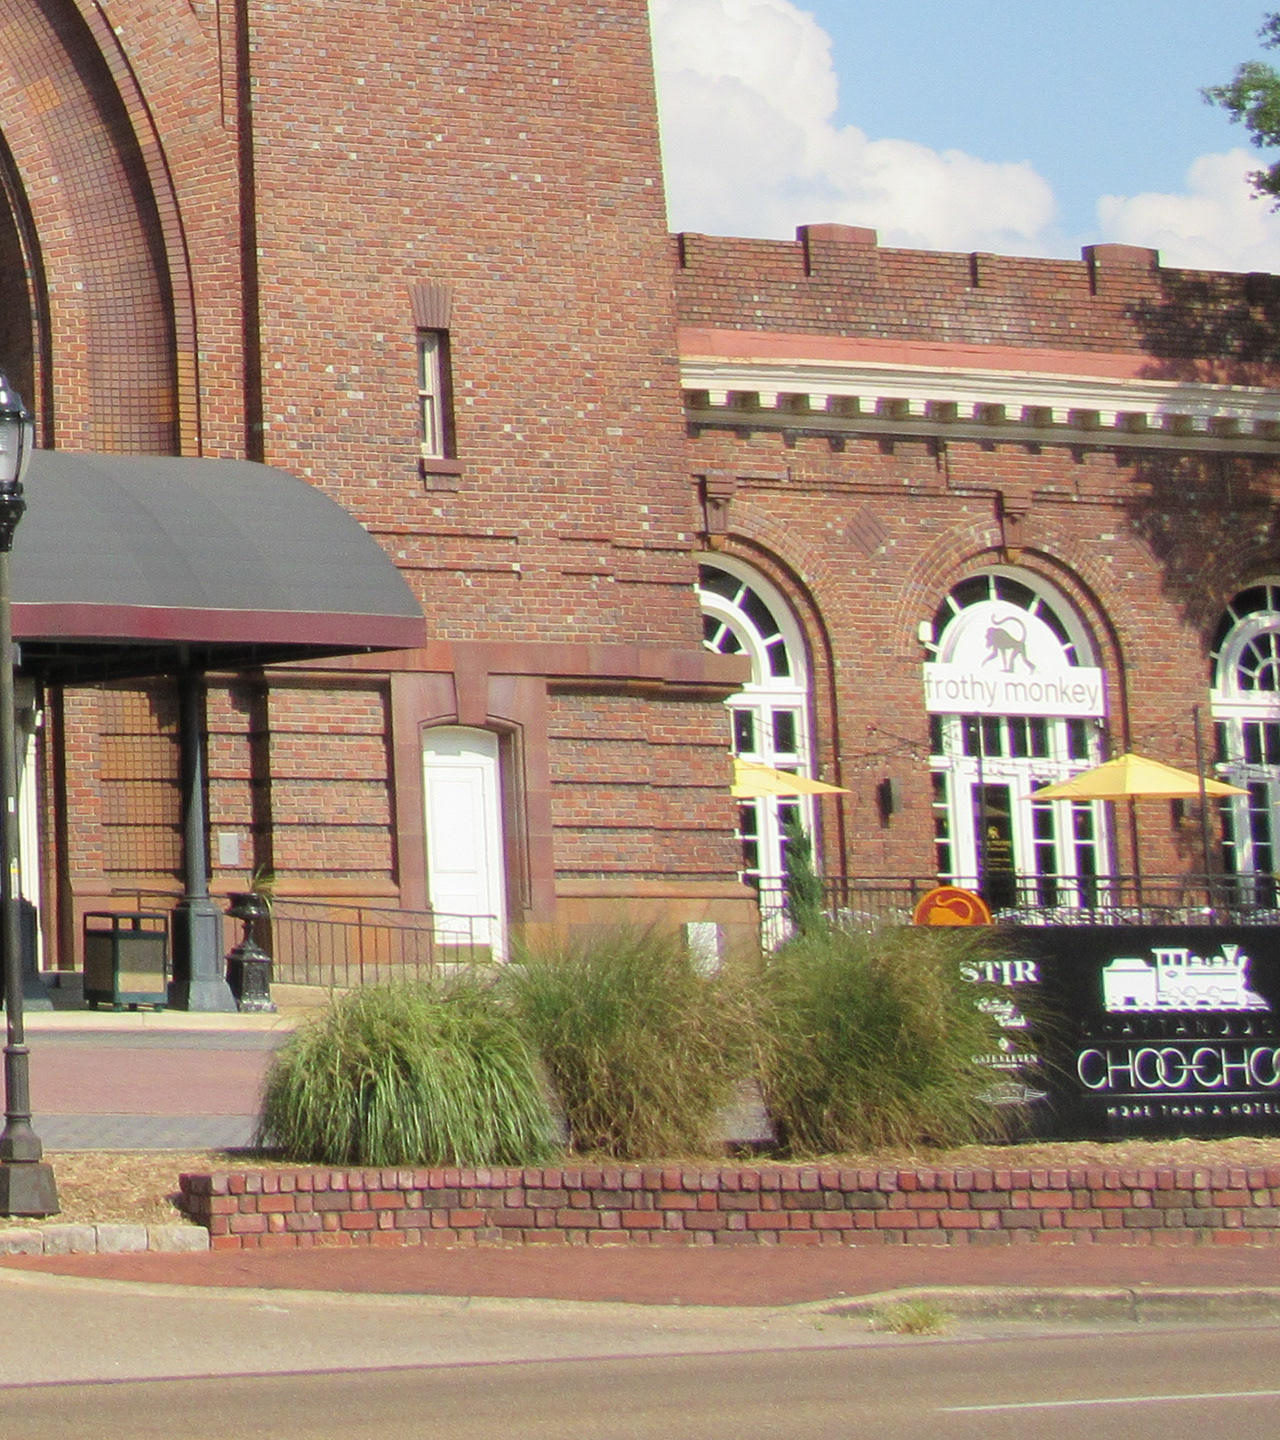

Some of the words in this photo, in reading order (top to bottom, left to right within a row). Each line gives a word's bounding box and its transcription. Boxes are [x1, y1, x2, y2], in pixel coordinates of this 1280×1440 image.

[924, 672, 997, 707] frothy
[1005, 676, 1098, 710] monkey
[960, 960, 1038, 986] STIR
[1077, 1046, 1280, 1089] CHOO-CHO
[1106, 1105, 1152, 1117] MORE
[1160, 1104, 1205, 1115] THAN
[1212, 1105, 1223, 1115] A
